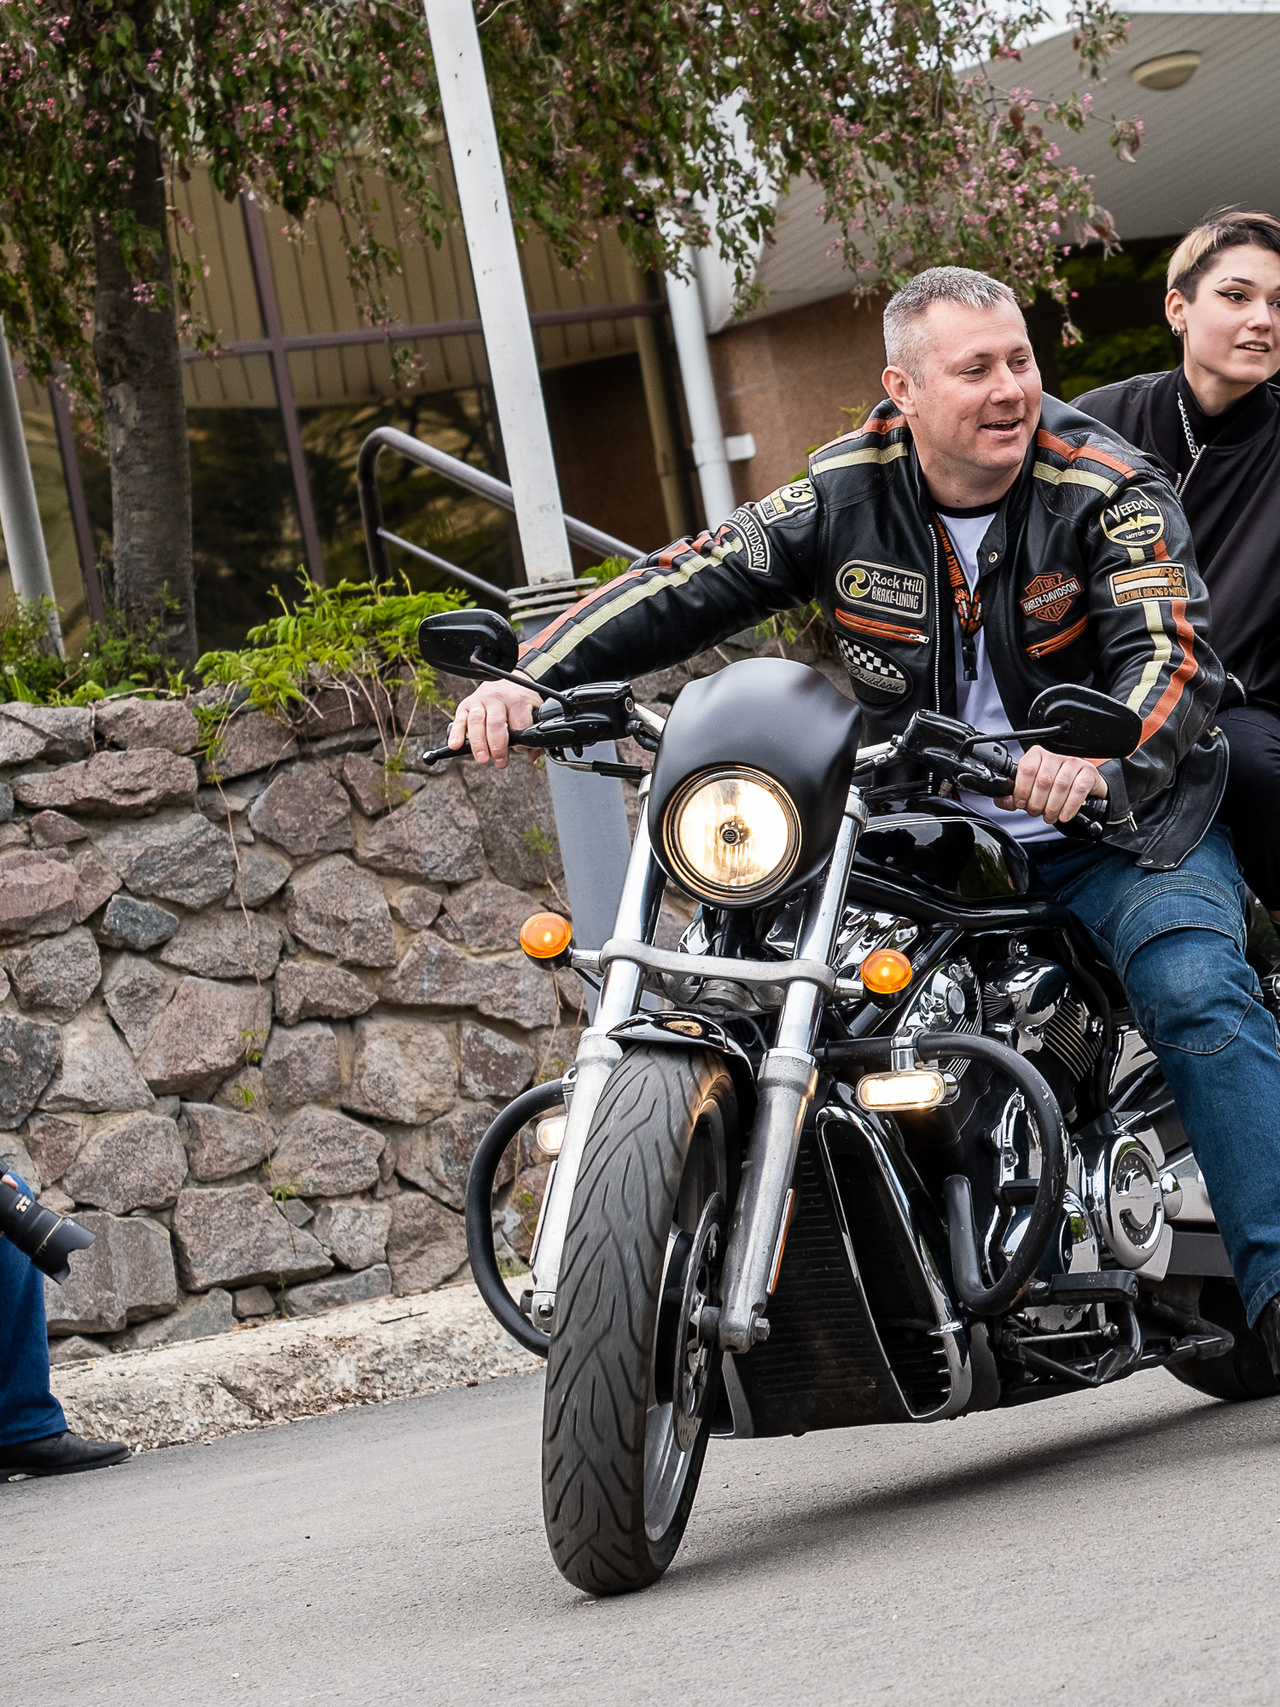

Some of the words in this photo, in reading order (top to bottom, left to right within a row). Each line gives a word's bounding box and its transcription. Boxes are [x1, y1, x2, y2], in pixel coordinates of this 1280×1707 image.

[1106, 498, 1156, 523] VEEDOL
[1125, 530, 1145, 540] MOTOR
[871, 570, 900, 590] Rock
[903, 577, 923, 594] Hill
[1023, 580, 1079, 613] HARLEY-DAVIDSON
